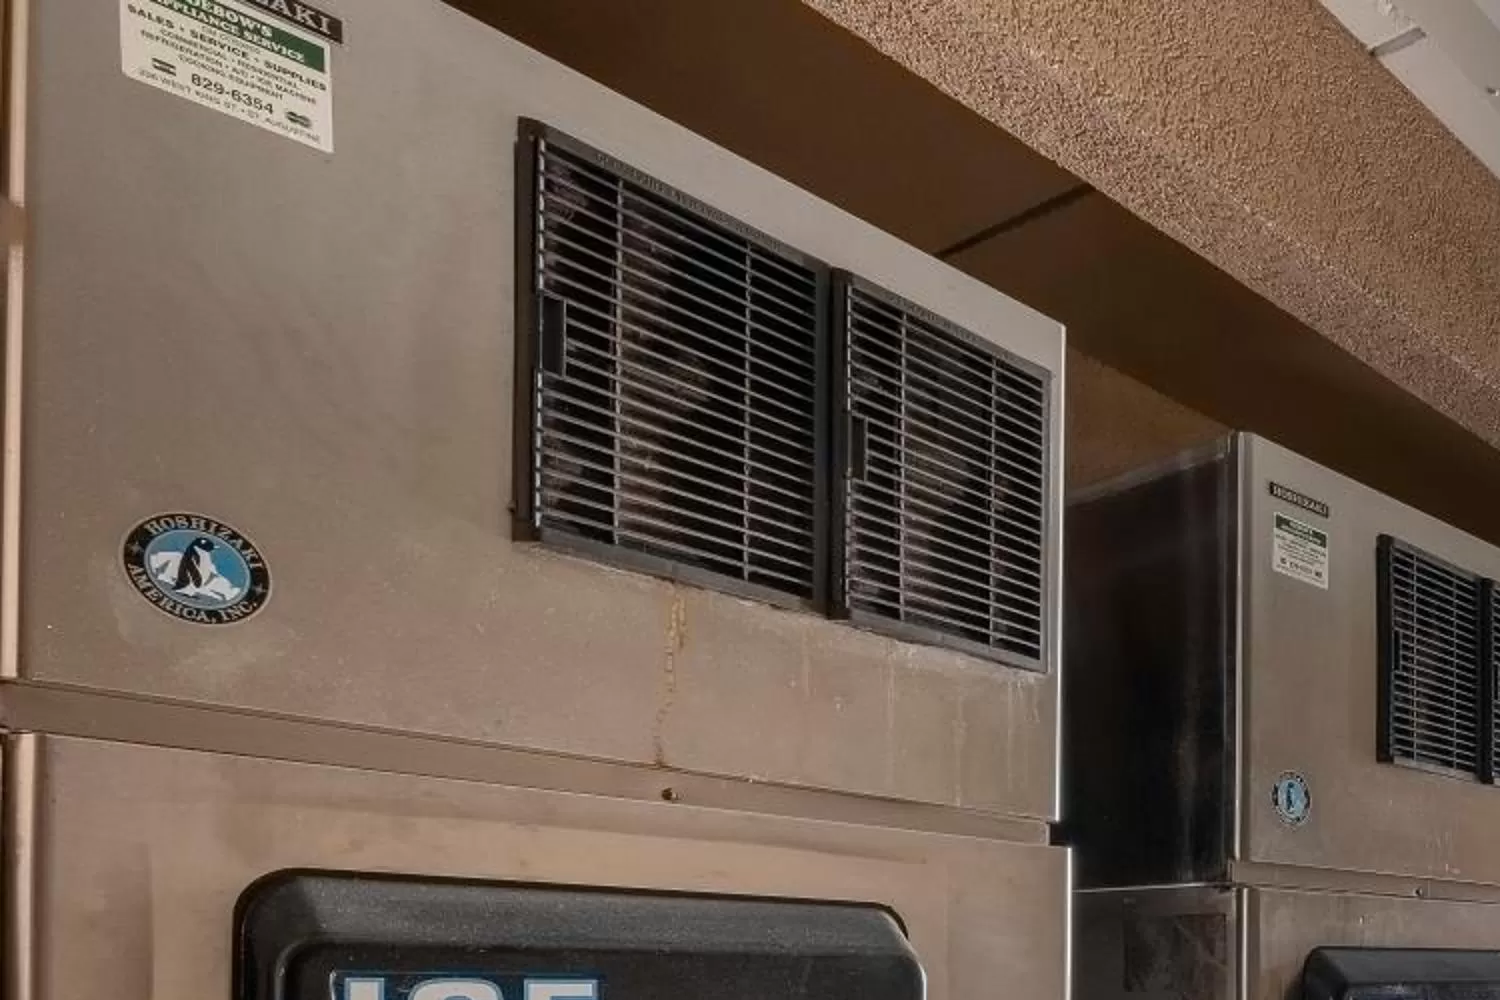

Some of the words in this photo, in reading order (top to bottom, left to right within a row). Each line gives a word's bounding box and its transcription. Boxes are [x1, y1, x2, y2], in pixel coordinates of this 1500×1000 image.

[127, 3, 175, 29] SALES
[190, 29, 248, 58] SERVICE
[263, 60, 327, 92] SUPPLIES
[191, 73, 273, 114] 829-6354
[143, 514, 263, 569] HOSHIZAKI
[219, 600, 258, 621] INC.
